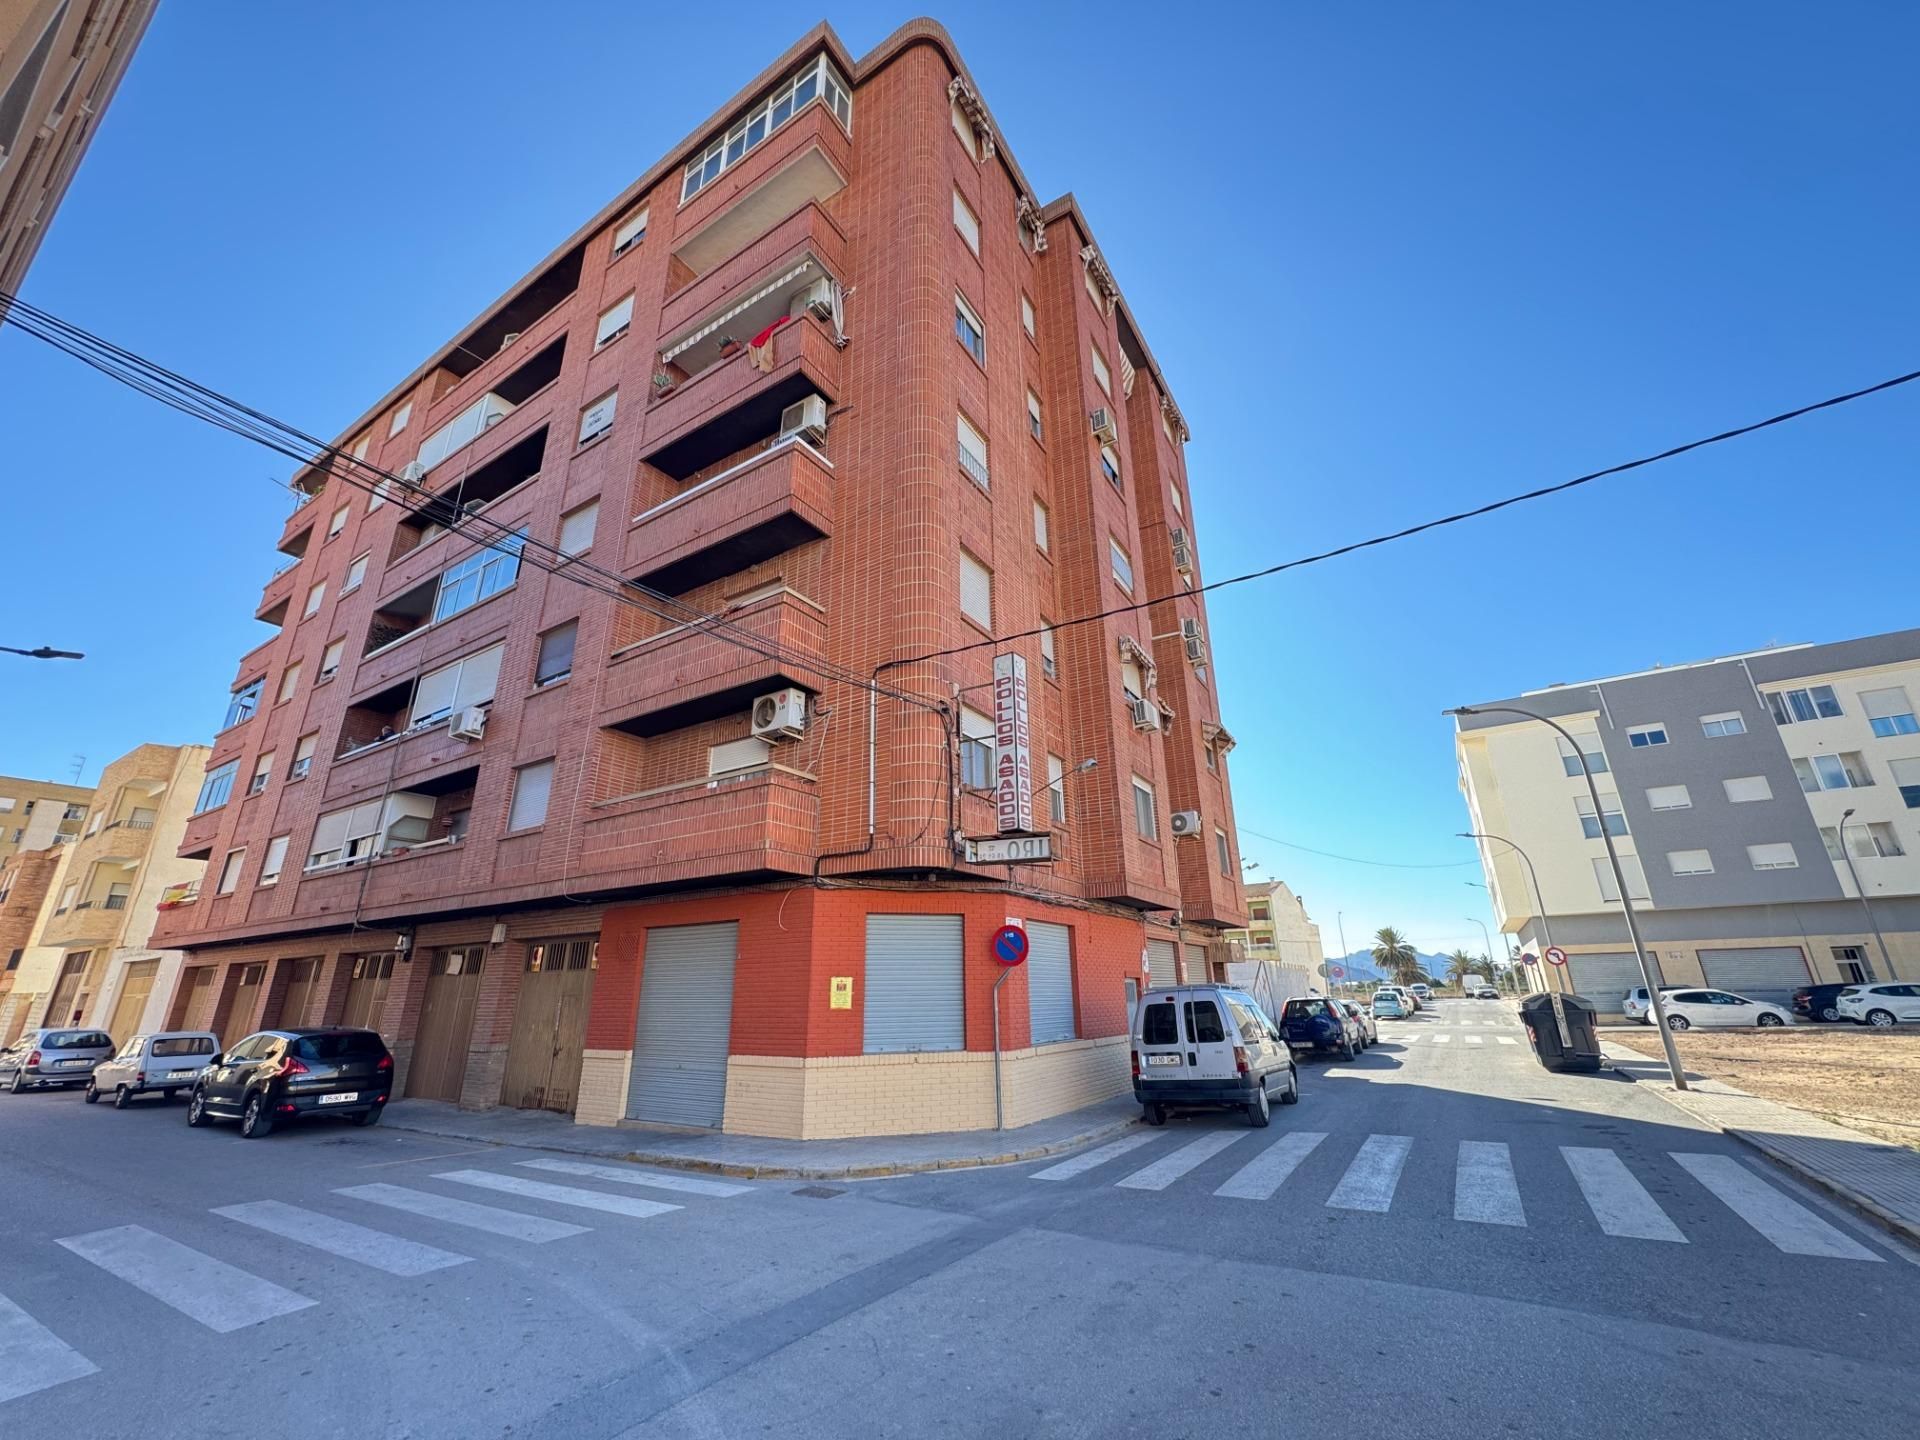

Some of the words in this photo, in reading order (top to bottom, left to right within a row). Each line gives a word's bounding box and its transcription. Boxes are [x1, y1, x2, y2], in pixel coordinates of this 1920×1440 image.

[996, 677, 1013, 747] POLLOS
[1016, 677, 1027, 748] POLLOS
[999, 754, 1015, 828] ASADOS
[1019, 755, 1031, 828] ASADOS
